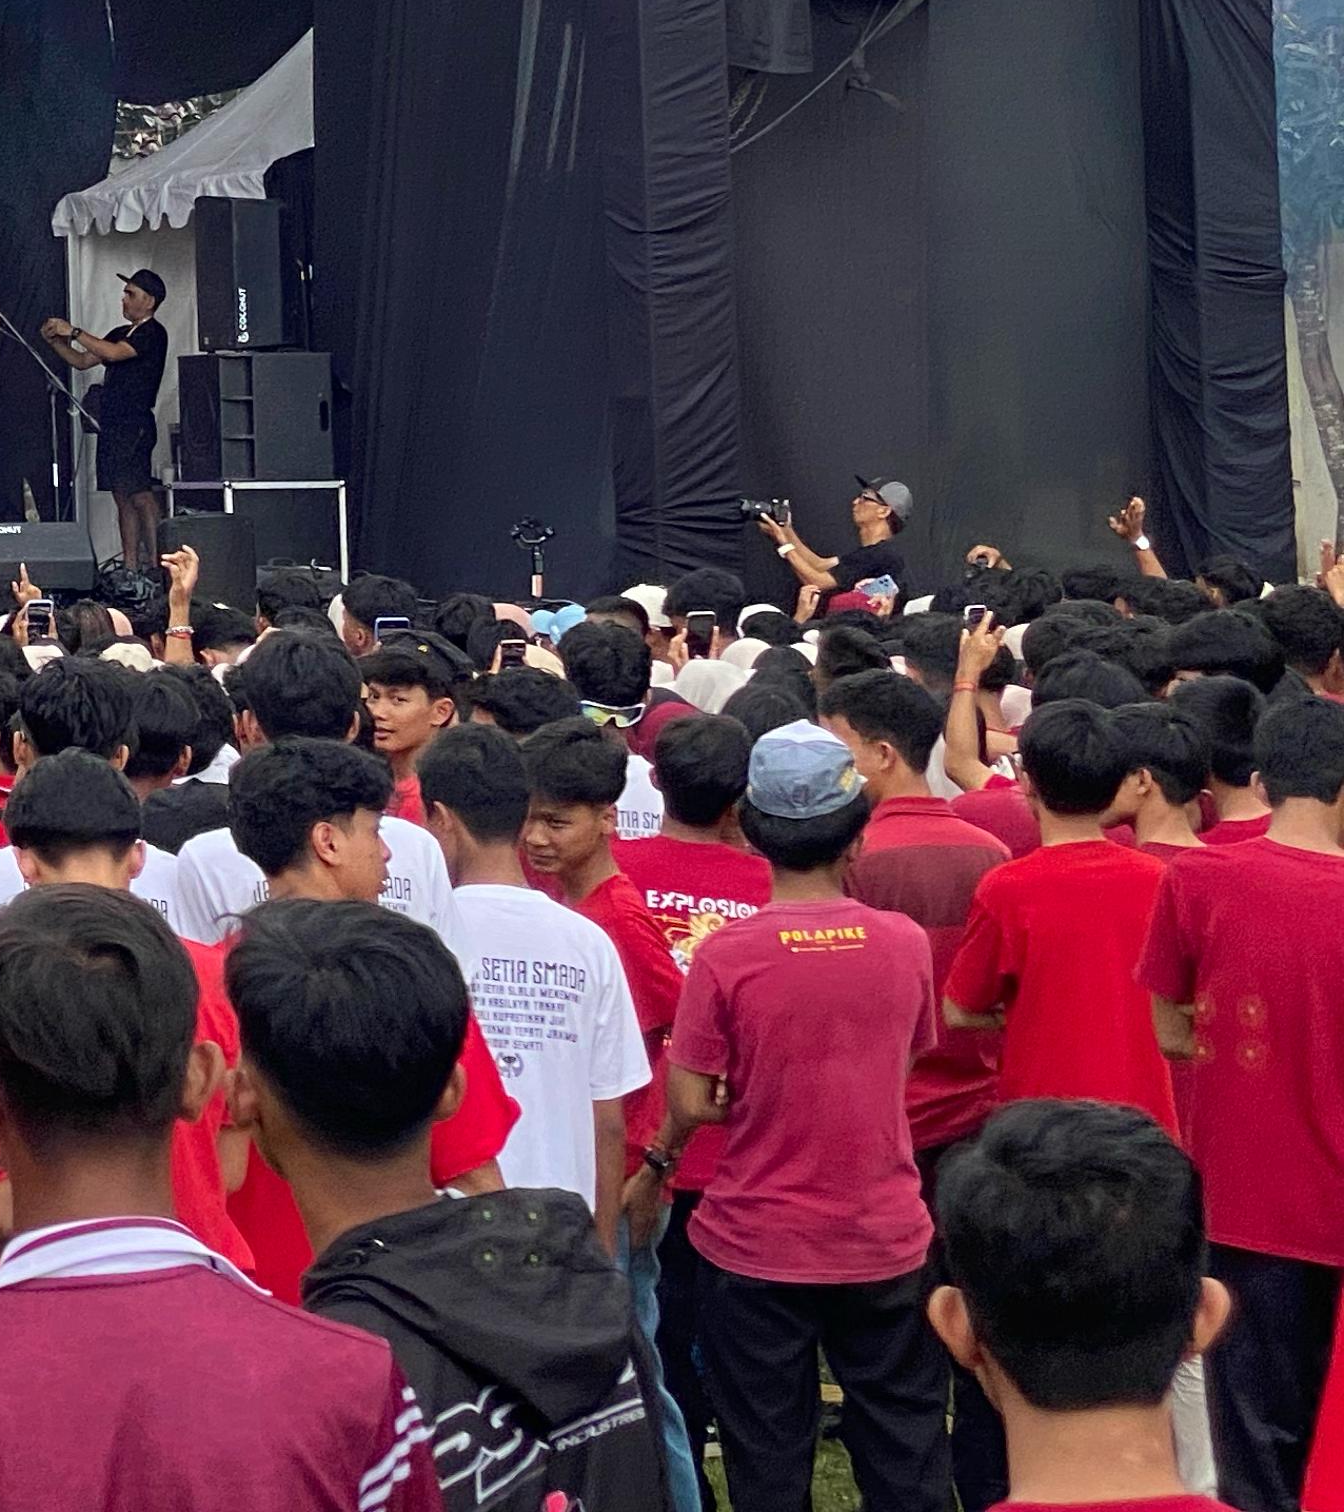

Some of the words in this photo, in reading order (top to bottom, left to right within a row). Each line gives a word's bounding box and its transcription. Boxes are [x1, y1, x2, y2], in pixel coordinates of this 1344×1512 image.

[779, 927, 866, 945] POLAPIKE
[482, 957, 528, 984] SETIA
[532, 961, 586, 993] SMADA
